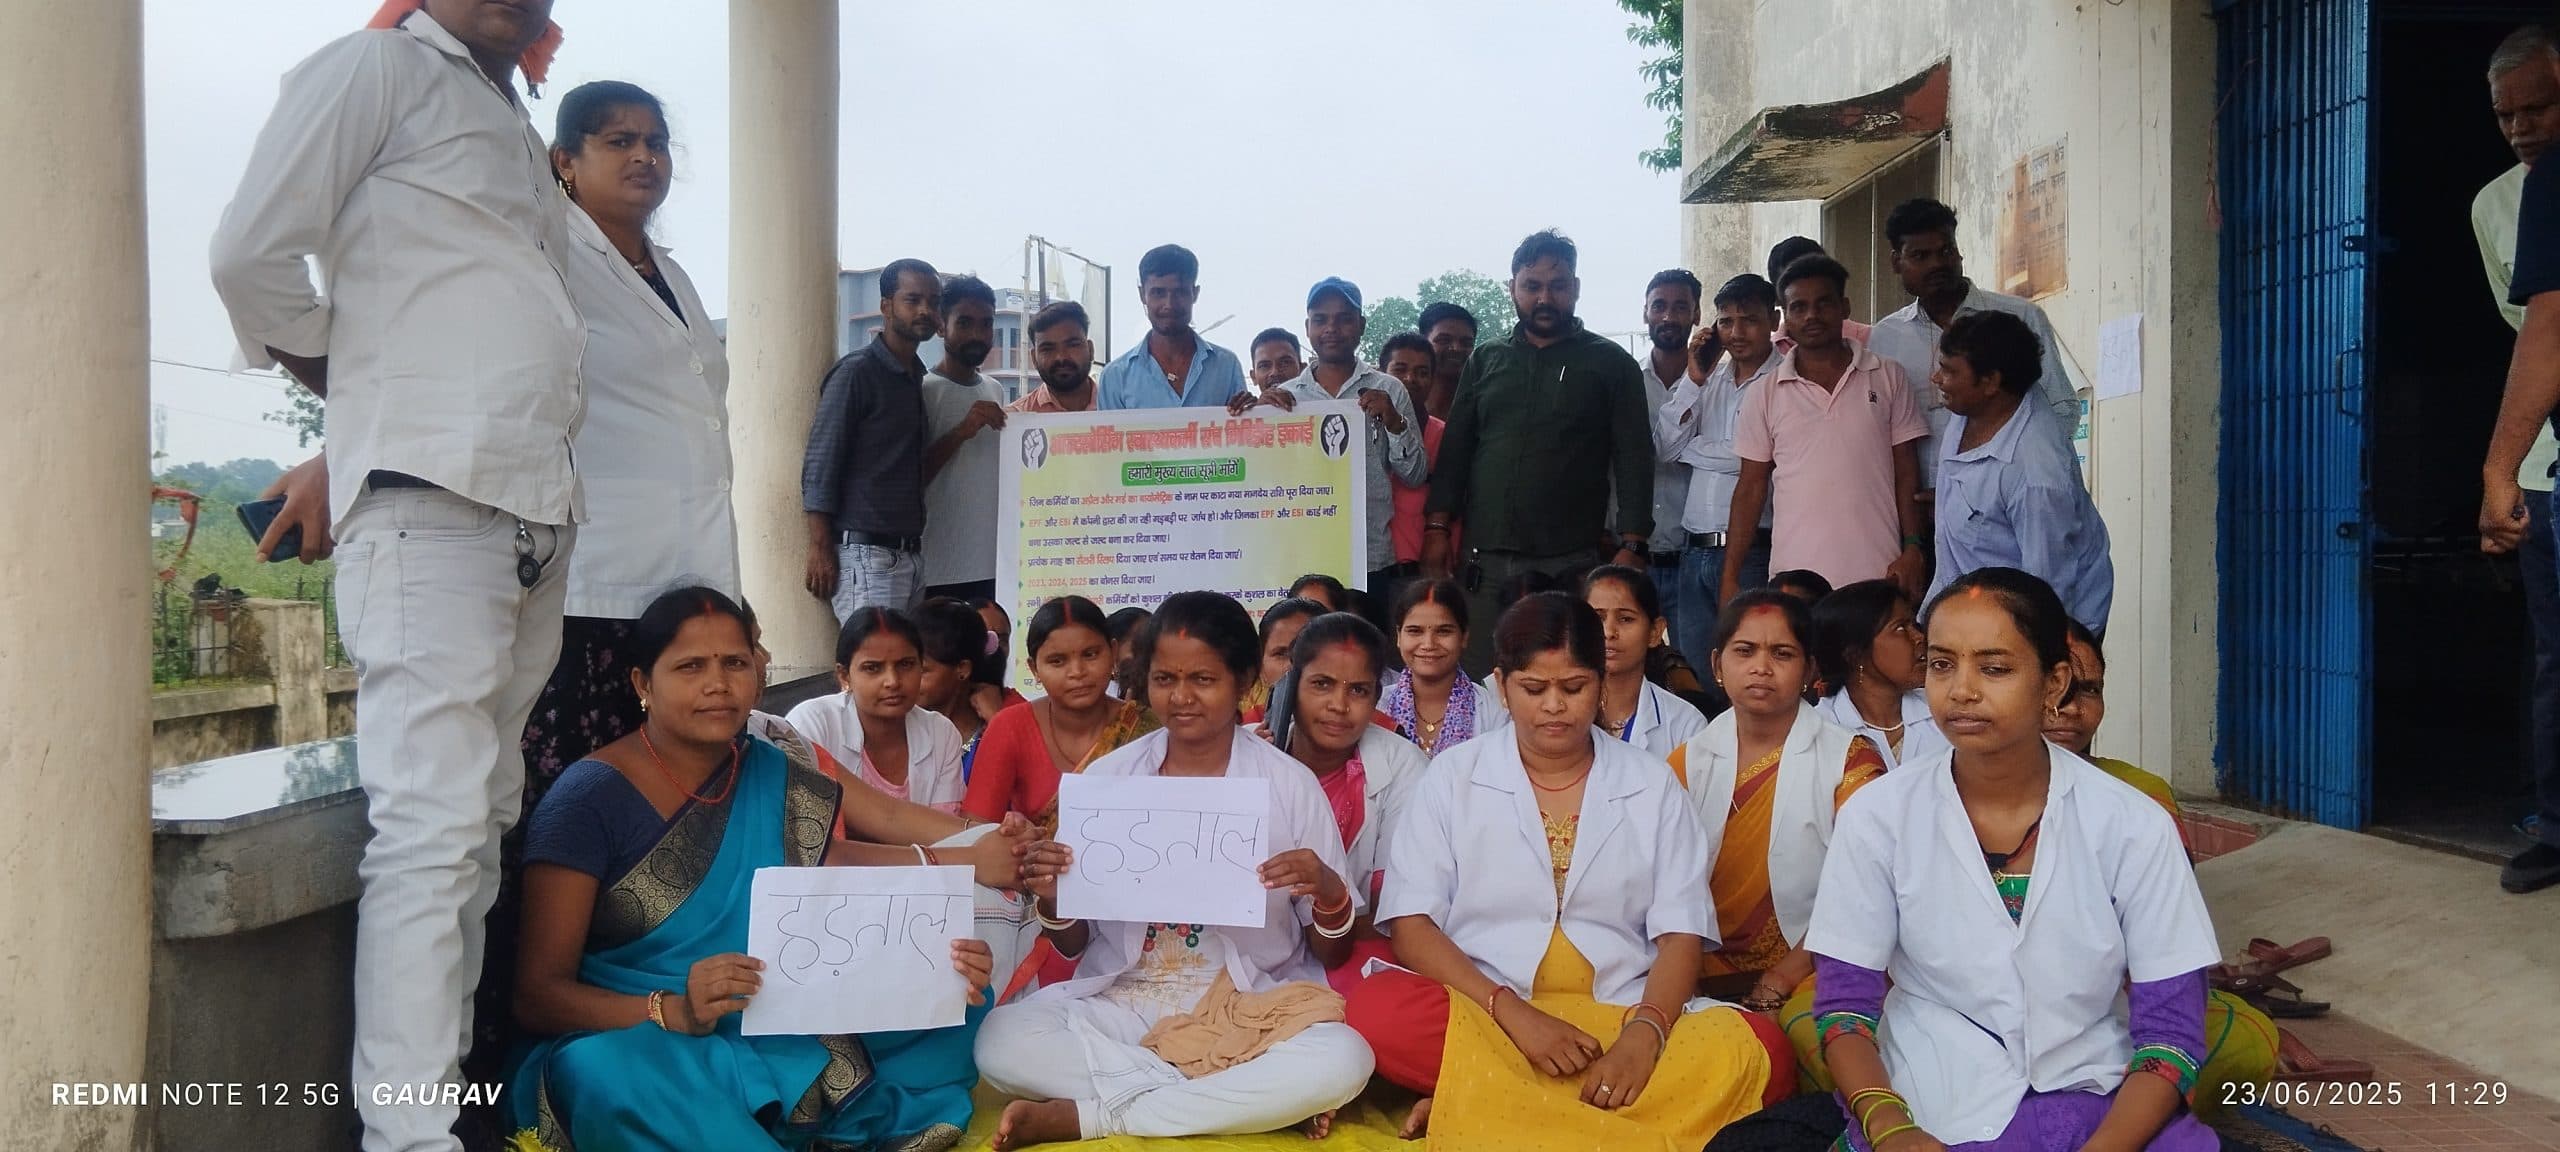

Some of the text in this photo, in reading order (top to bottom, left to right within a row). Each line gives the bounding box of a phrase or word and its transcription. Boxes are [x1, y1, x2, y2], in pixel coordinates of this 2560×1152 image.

[1277, 415, 1315, 448] इकाई
[1128, 463, 1152, 480] हमारी
[1154, 466, 1176, 483] मुख्य
[1179, 465, 1197, 479] सात
[1200, 460, 1217, 480] सूत्री
[1029, 496, 1044, 507] जिन
[1070, 497, 1080, 505] का
[1128, 495, 1137, 503] का
[1175, 491, 1182, 501] के
[1184, 493, 1198, 501] नाम
[1200, 492, 1209, 500] पर
[1210, 491, 1226, 500] काटा
[1228, 491, 1242, 499] गया
[1244, 487, 1268, 499] मानदेय
[1270, 486, 1284, 497] राशि
[1299, 485, 1313, 496] दिया
[1045, 516, 1057, 527] और
[1117, 513, 1126, 524] की
[1128, 516, 1138, 524] जा
[1140, 513, 1151, 524] रही
[1178, 514, 1188, 522] पर
[1220, 509, 1233, 520] और
[1234, 508, 1259, 520] जिनका
[1261, 510, 1274, 519] EPF
[1277, 507, 1290, 518] और
[1292, 508, 1303, 517] ESI
[1306, 504, 1321, 516] कार्ड
[1323, 504, 1338, 516] नहीं
[1043, 538, 1062, 546] उसका
[1065, 537, 1080, 546] जल्द
[1082, 535, 1089, 545] से
[1090, 537, 1106, 545] जल्द
[1136, 532, 1151, 543] दिया
[1050, 558, 1063, 566] माह
[1065, 557, 1075, 566] का
[1116, 552, 1130, 563] दिया
[1148, 551, 1160, 562] एवं
[1160, 553, 1178, 562] समय
[1179, 553, 1188, 561] पर
[1190, 550, 1206, 561] वेतन
[1208, 549, 1223, 560] दिया
[1089, 577, 1099, 585] का
[1121, 573, 1136, 584] दिया
[1130, 593, 1140, 603] को
[1141, 594, 1161, 607] कुशल
[1244, 590, 1265, 602] कुशल
[1070, 805, 1260, 886] हड़ताल
[768, 893, 973, 985] हड़ताल
